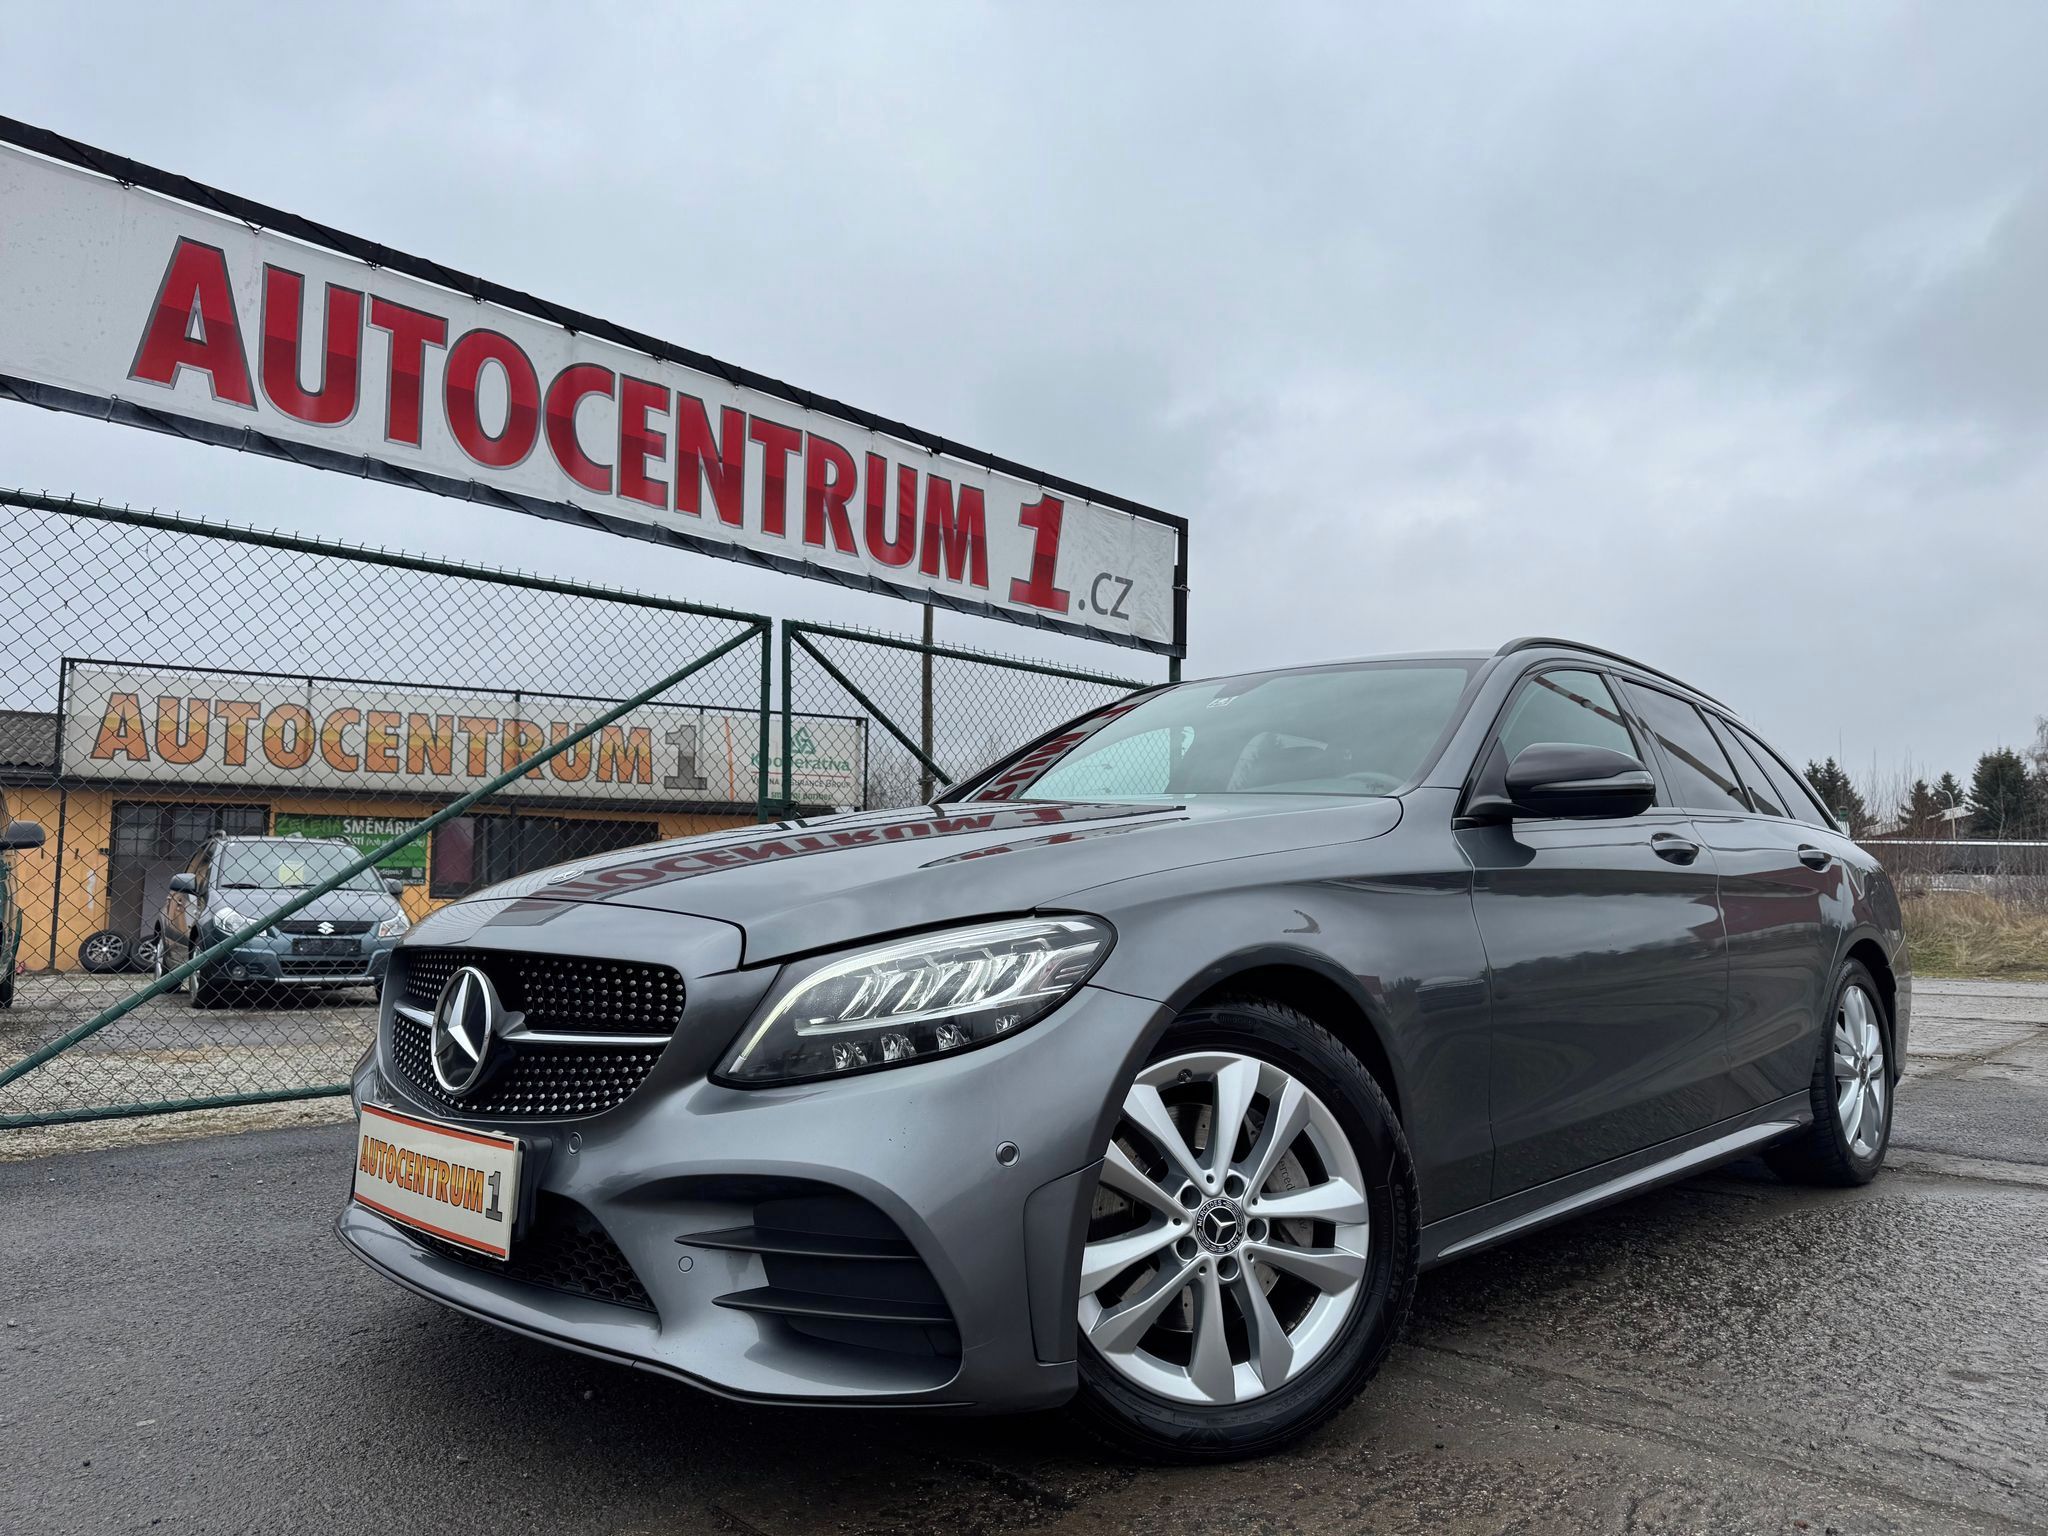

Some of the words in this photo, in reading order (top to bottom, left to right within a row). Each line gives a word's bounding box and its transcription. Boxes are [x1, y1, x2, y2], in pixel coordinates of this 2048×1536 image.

[127, 235, 990, 591] AUTOCENTRUM
[91, 691, 654, 785] AUTOCENTRUM
[663, 724, 708, 790] 1
[343, 817, 418, 835] SMĚNÁRN
[359, 1135, 485, 1214] AUTOCENTRUM
[485, 1171, 503, 1222] 1
